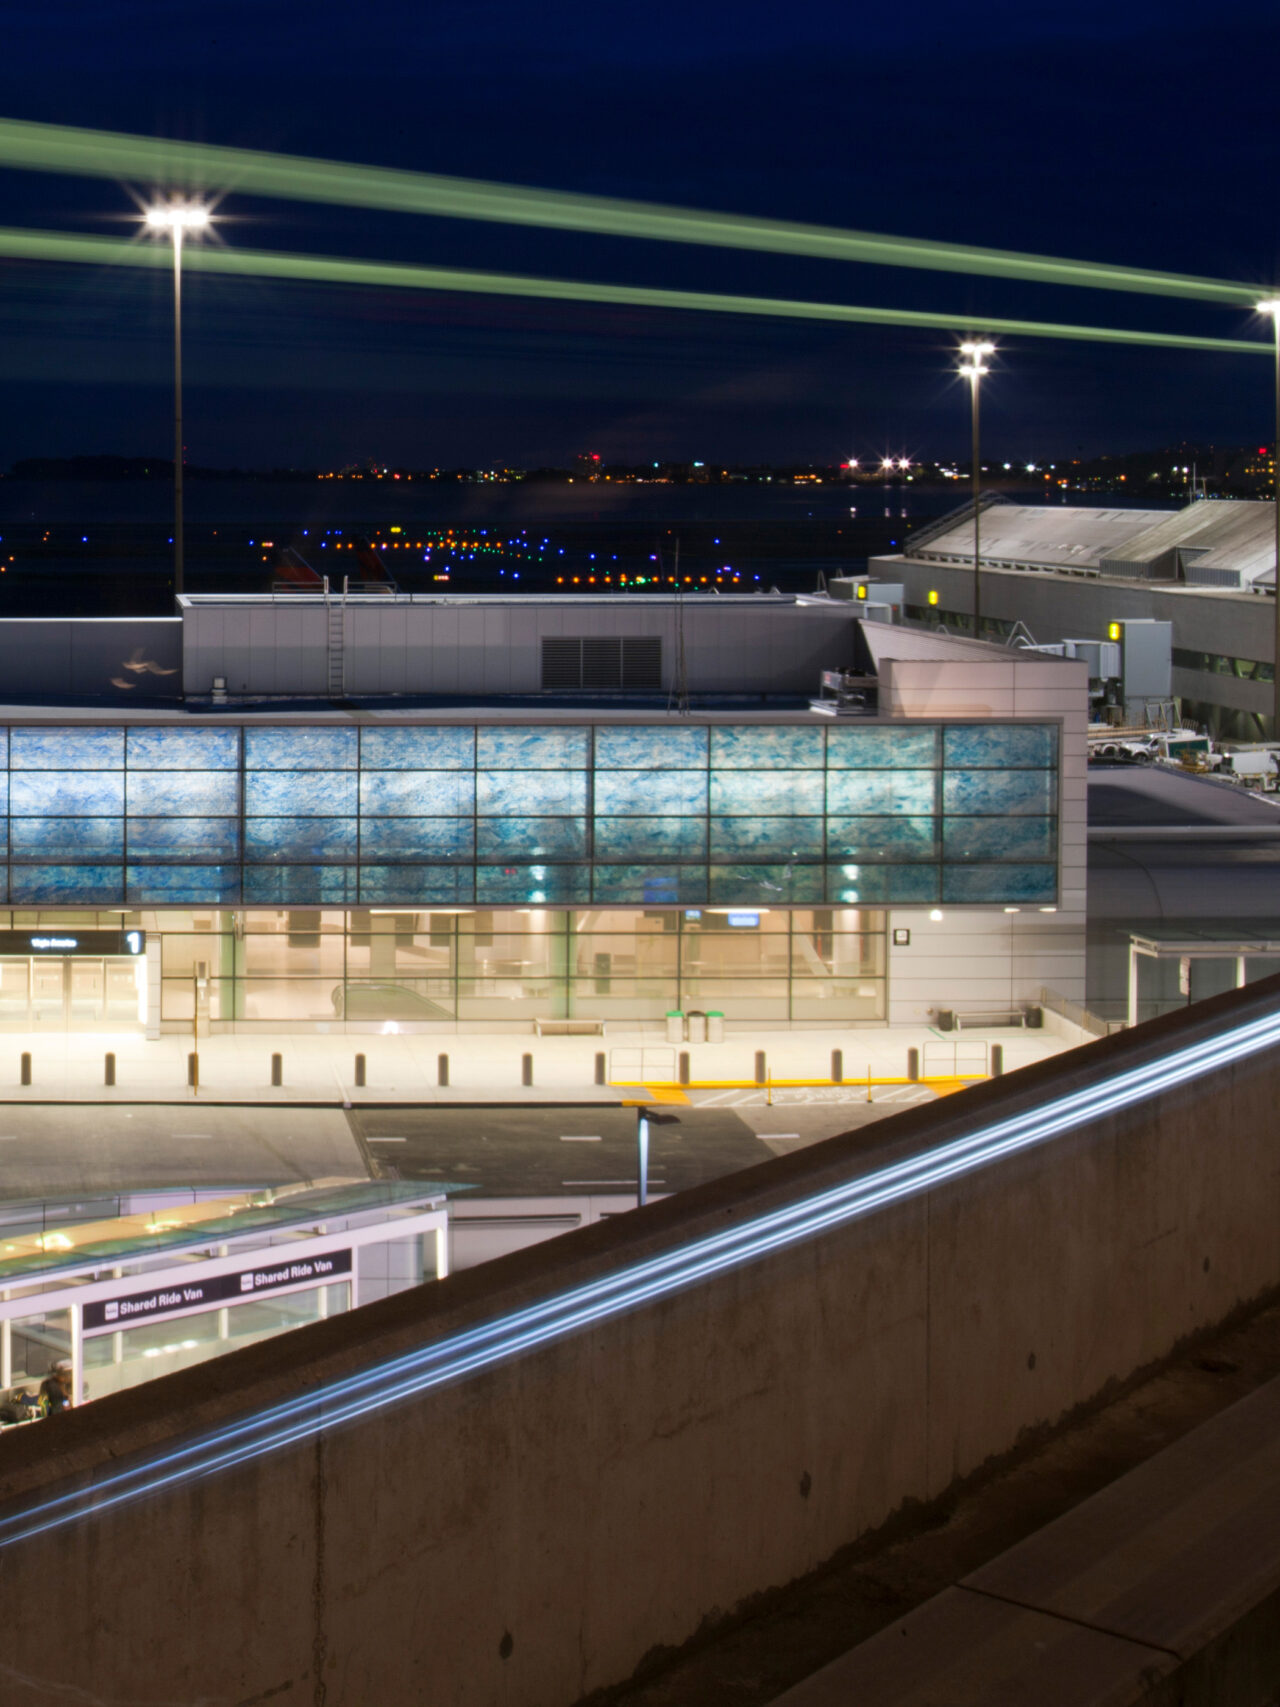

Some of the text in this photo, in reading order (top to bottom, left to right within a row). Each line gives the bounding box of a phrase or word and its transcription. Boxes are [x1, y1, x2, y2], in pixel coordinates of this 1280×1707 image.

[126, 931, 141, 954] 1
[254, 1260, 333, 1287] Shared Ride Van
[120, 1287, 204, 1315] Shared Ride Van
